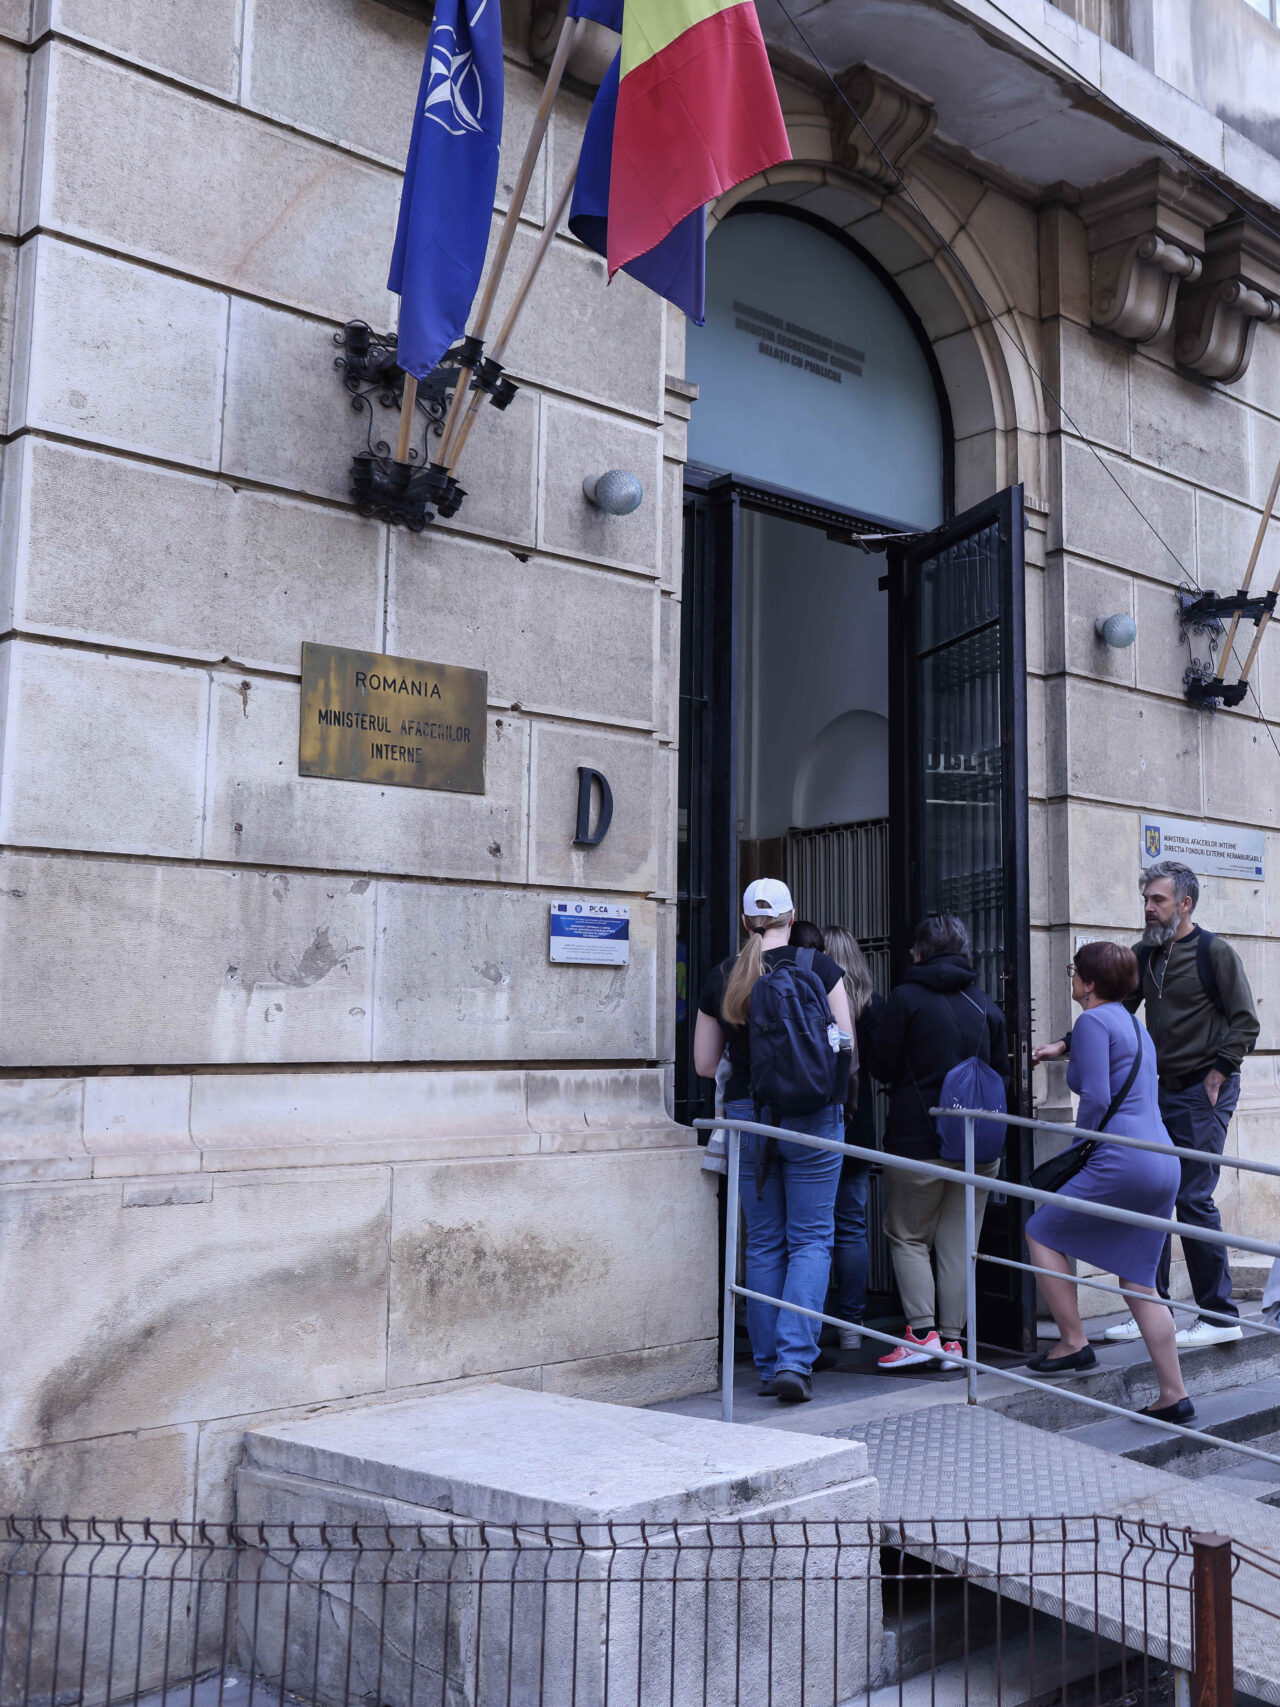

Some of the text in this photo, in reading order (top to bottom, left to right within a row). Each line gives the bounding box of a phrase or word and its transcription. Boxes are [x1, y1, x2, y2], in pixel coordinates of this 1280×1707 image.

[355, 671, 442, 699] ROMÂNIA
[318, 708, 472, 743] MINISTERUL AFACERILOR
[371, 743, 425, 765] INTERNE
[572, 766, 614, 845] D
[1163, 835, 1190, 845] MINISTERUL
[1191, 839, 1218, 848] AFACERILOR
[1185, 847, 1205, 855] FONDURI
[1205, 850, 1226, 859] EXTERNE
[1227, 853, 1262, 862] NERAMBURSABILE
